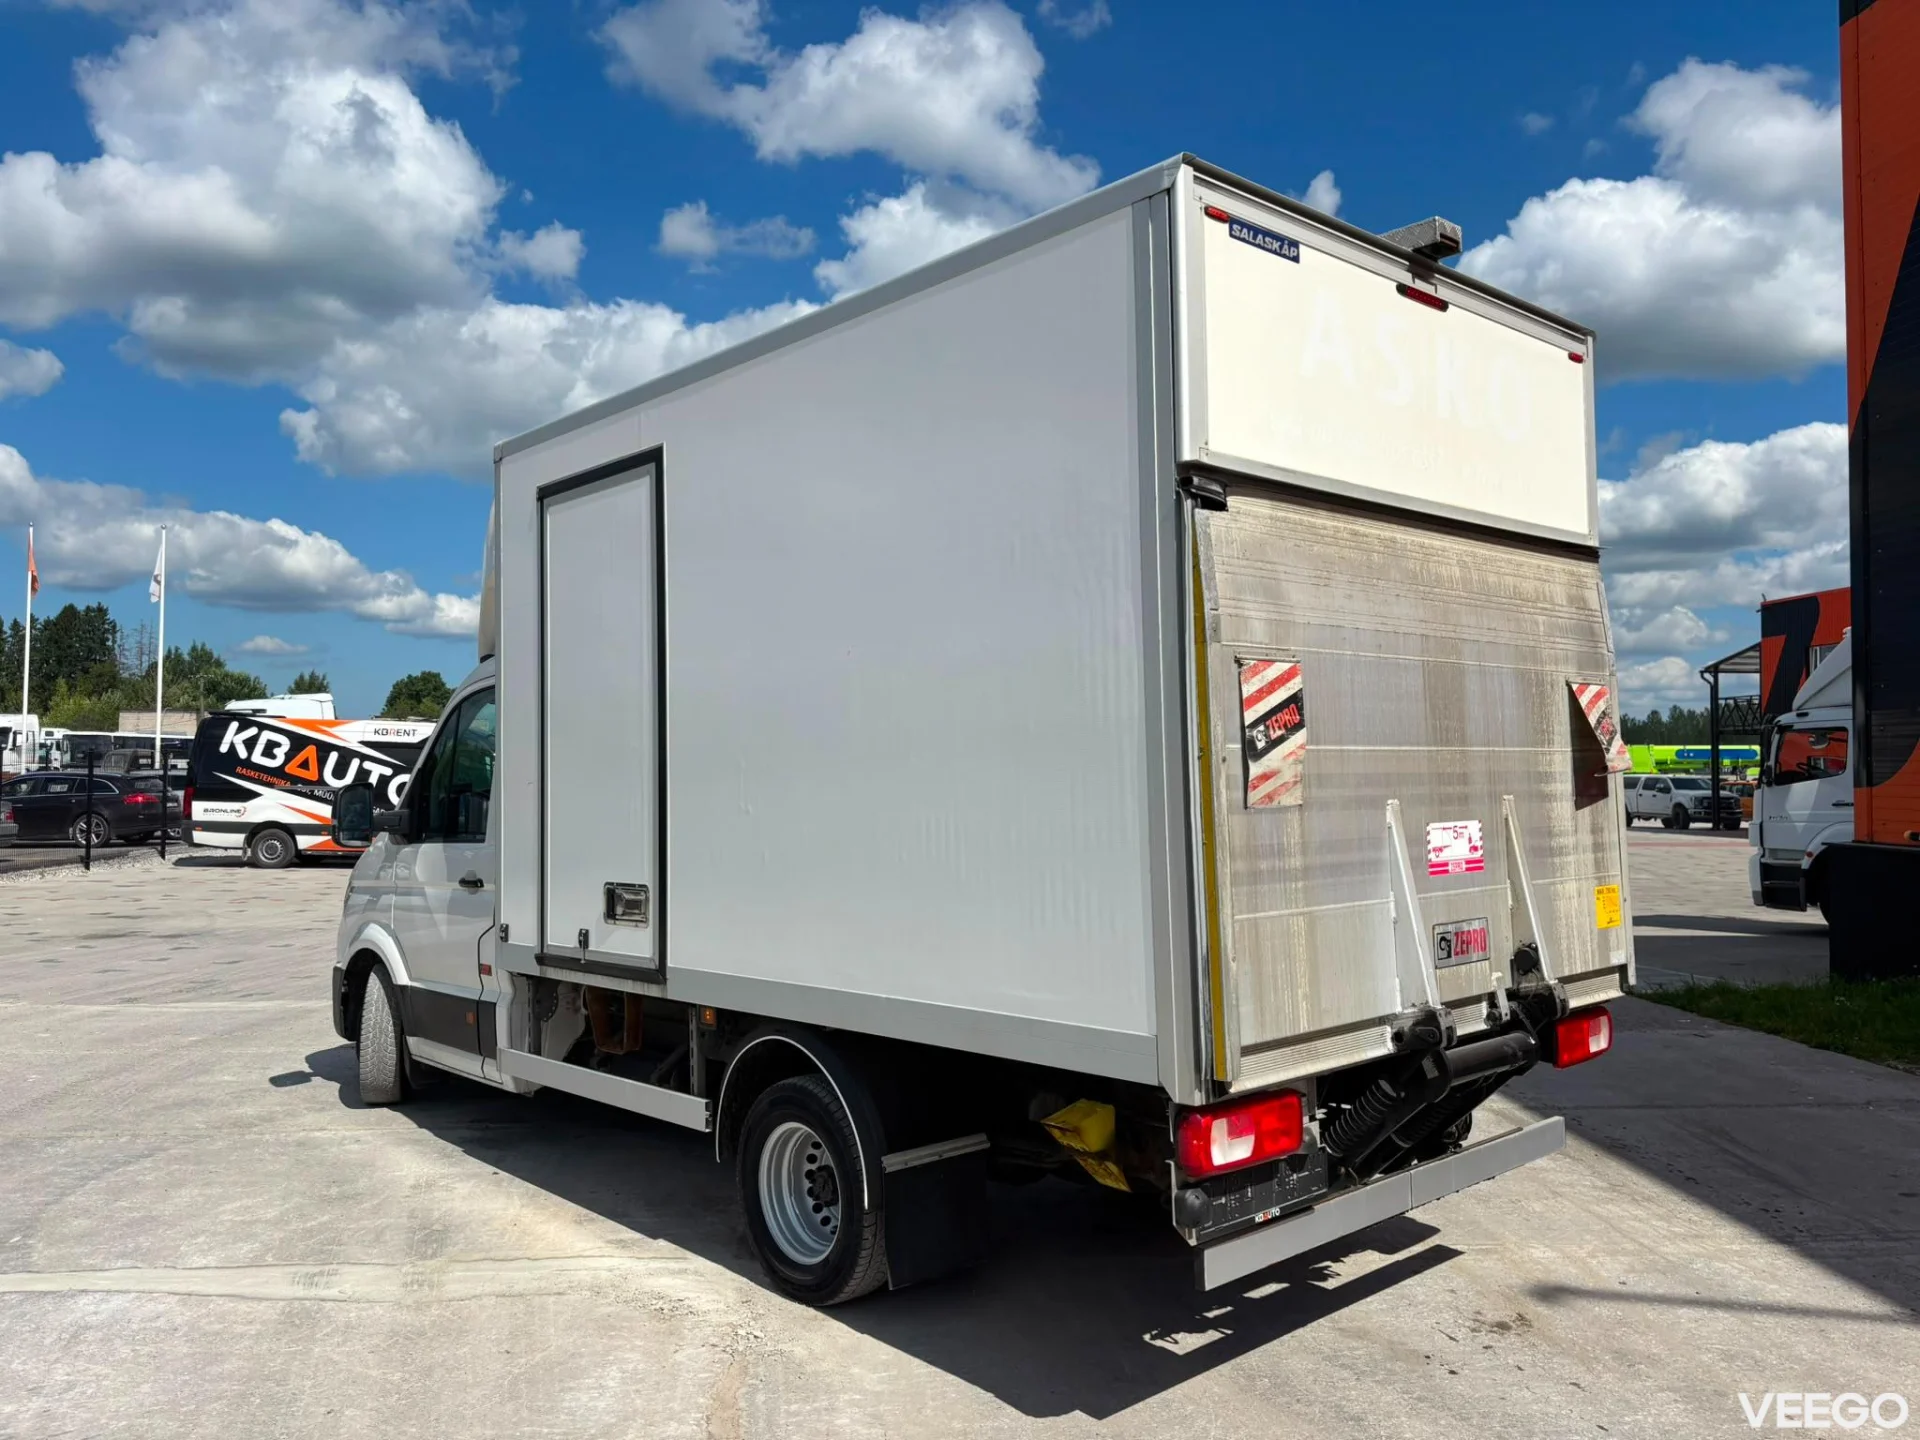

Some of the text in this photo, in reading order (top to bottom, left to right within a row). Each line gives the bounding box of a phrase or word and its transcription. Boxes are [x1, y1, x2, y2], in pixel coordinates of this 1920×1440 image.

[1231, 223, 1298, 257] SALASKÅP
[1265, 703, 1300, 740] ZEPRO
[1454, 927, 1487, 956] ZEPRO
